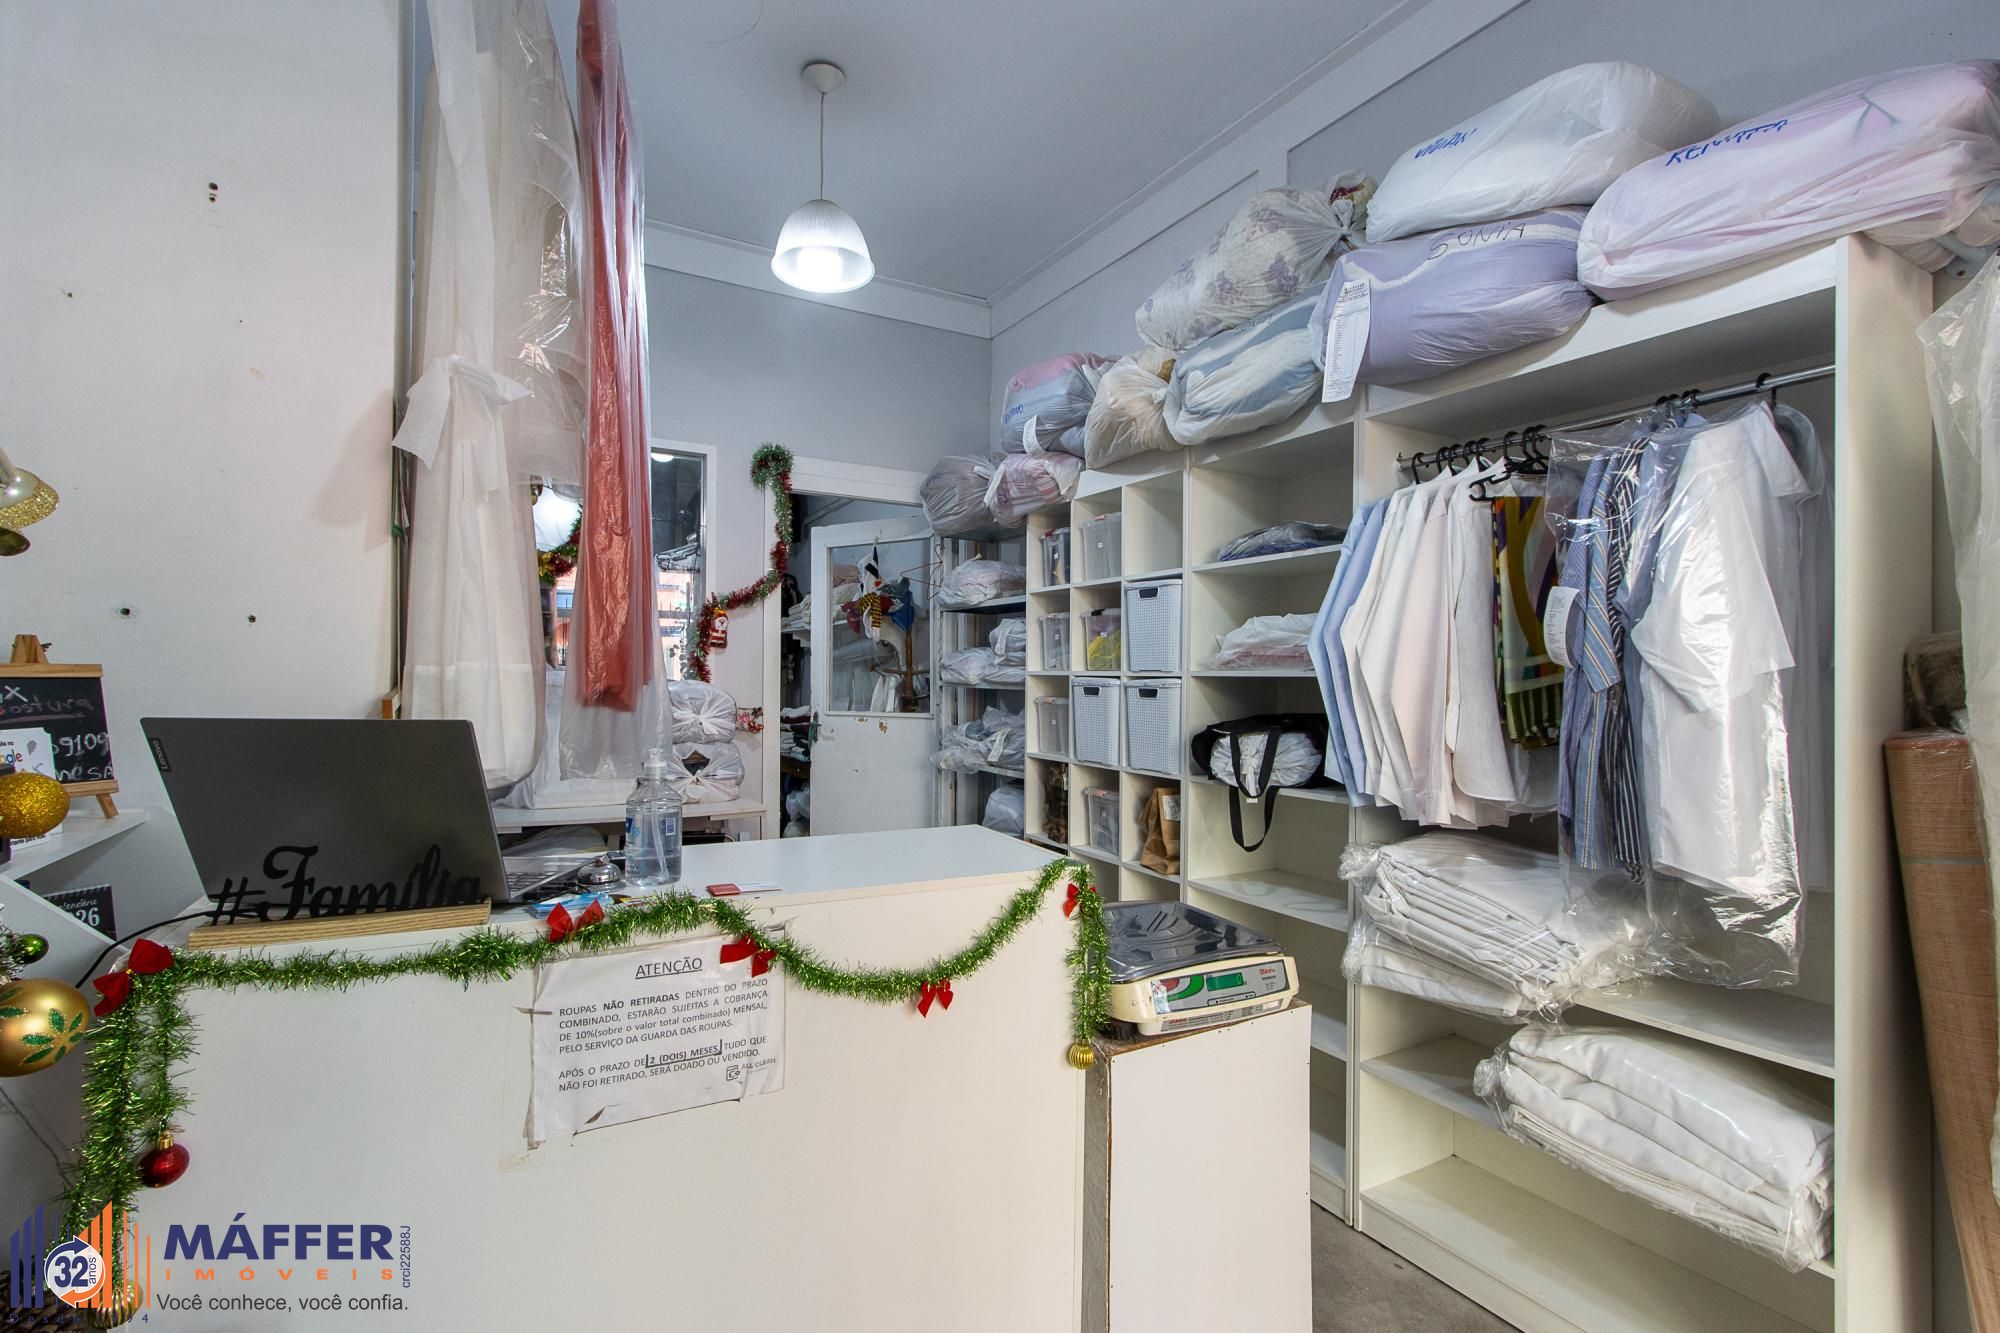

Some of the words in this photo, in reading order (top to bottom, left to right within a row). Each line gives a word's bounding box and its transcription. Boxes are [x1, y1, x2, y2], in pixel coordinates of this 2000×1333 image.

[635, 956, 702, 977] ATENÇÃO
[560, 1004, 597, 1017] ROUPAS
[603, 1000, 625, 1011] NÃO
[630, 992, 680, 1007] RETIRADAS
[685, 986, 719, 999] DENTRO
[724, 983, 737, 992] DO
[742, 978, 768, 989] PRAZO
[560, 1013, 621, 1029] COMBINADO,
[627, 1006, 667, 1020] ESTARÃO
[672, 1001, 709, 1014] SUJEITAS
[724, 990, 768, 1004] COBRANÇA
[559, 1043, 583, 1054] PELO
[585, 1037, 624, 1051] SERVIÇO
[625, 1035, 639, 1045] DA
[640, 1028, 678, 1042] GUARDA
[680, 1025, 697, 1036] DAS
[698, 1019, 734, 1032] ROUPAS.
[560, 1032, 572, 1042] DE
[635, 1019, 657, 1031] valor
[660, 1017, 680, 1027] total
[682, 1009, 731, 1024] combinado)
[558, 1066, 584, 1080] APÓS
[588, 1066, 596, 1076] O
[600, 1060, 630, 1073] PRAZO
[634, 1058, 646, 1067] DE
[649, 1056, 656, 1065] 2
[659, 1051, 687, 1064] (DOIS)
[690, 1044, 718, 1057] MESES
[724, 1038, 747, 1050] TUDO
[749, 1034, 767, 1046] QUE
[558, 1080, 580, 1093] NÃO
[582, 1078, 598, 1089] FOI
[600, 1070, 647, 1086] RETIRADO,
[649, 1064, 672, 1077] SERÁ
[673, 1059, 705, 1072] DOADO
[707, 1056, 720, 1066] OU
[721, 1048, 761, 1062] VENDIDO.
